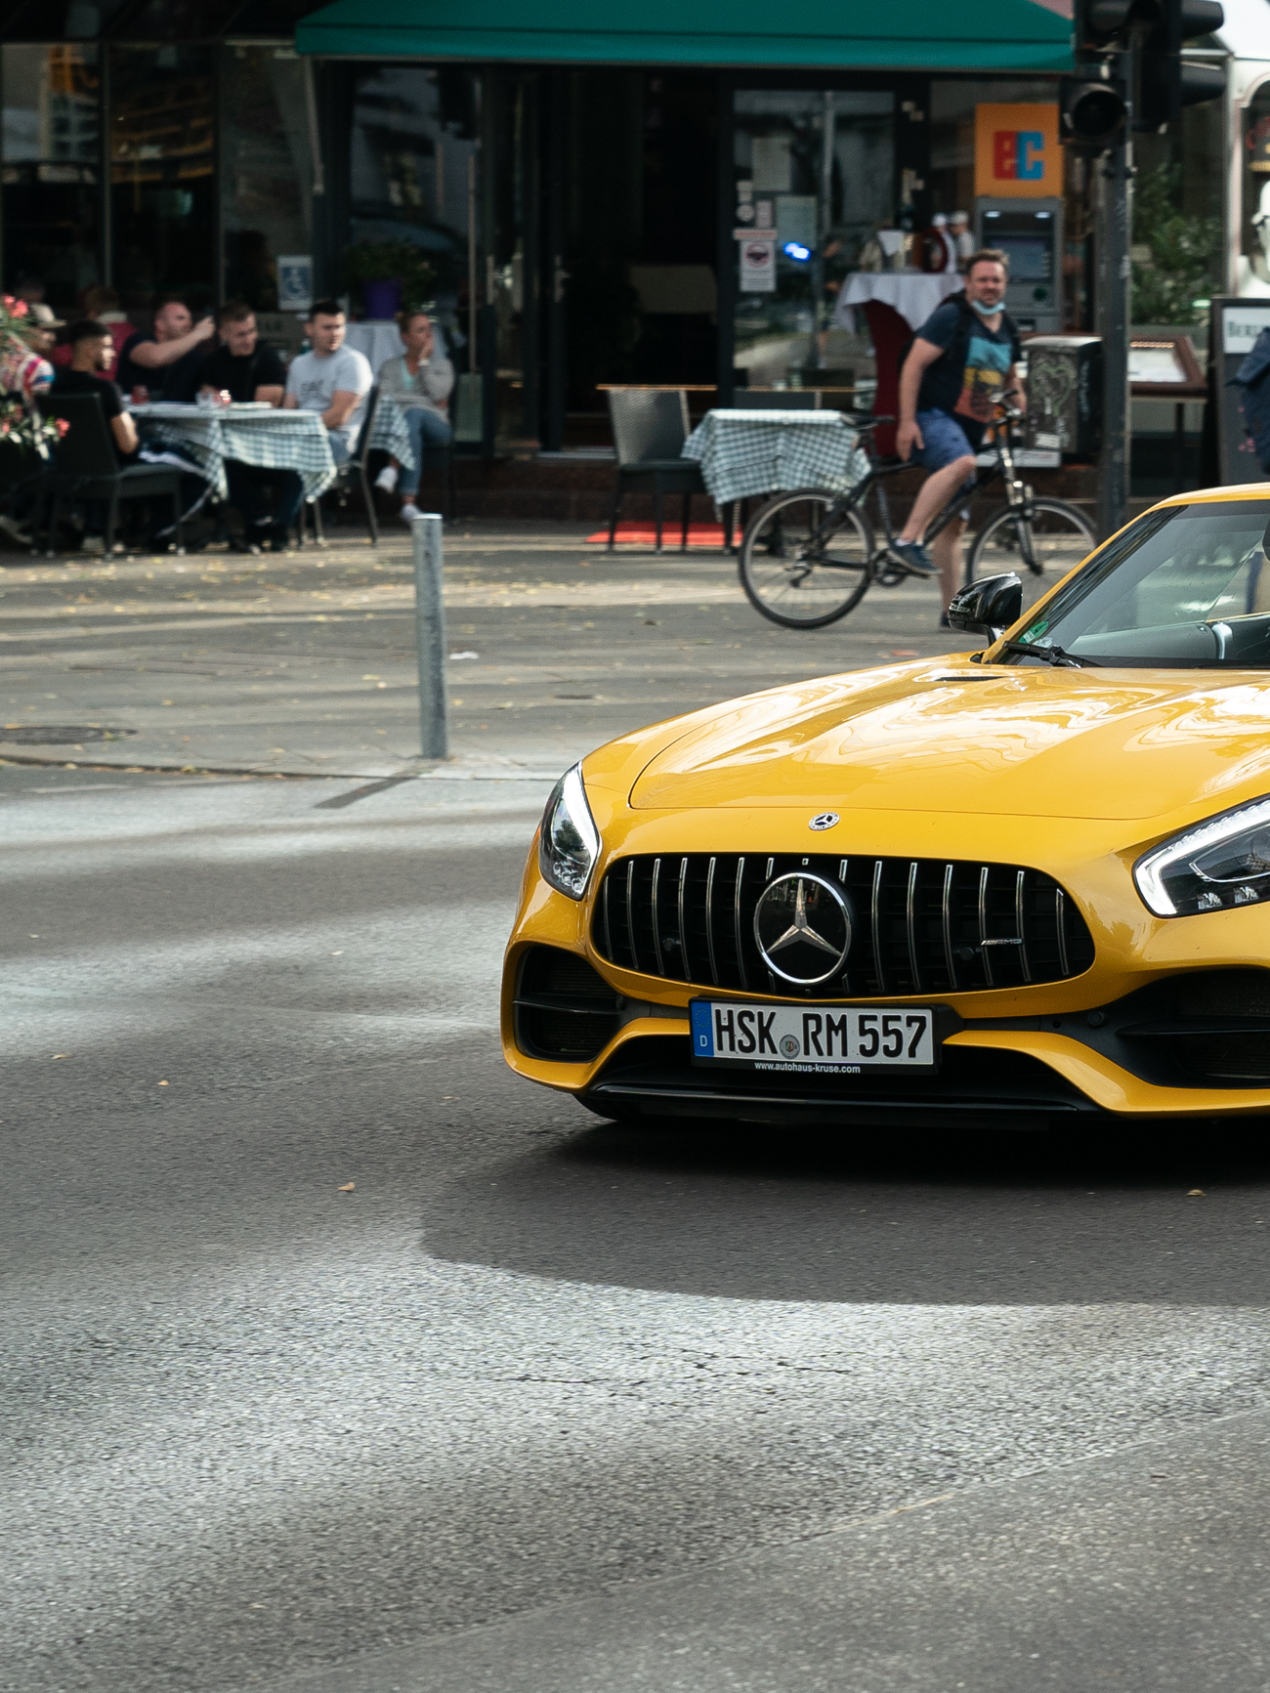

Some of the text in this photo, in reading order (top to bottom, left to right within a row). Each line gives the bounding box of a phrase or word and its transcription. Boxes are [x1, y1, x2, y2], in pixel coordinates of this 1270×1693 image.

[994, 131, 1044, 180] EC
[700, 1035, 708, 1047] D
[715, 1009, 927, 1058] HSK RM 557
[755, 1062, 861, 1074] www.autohaus-kruse.com
